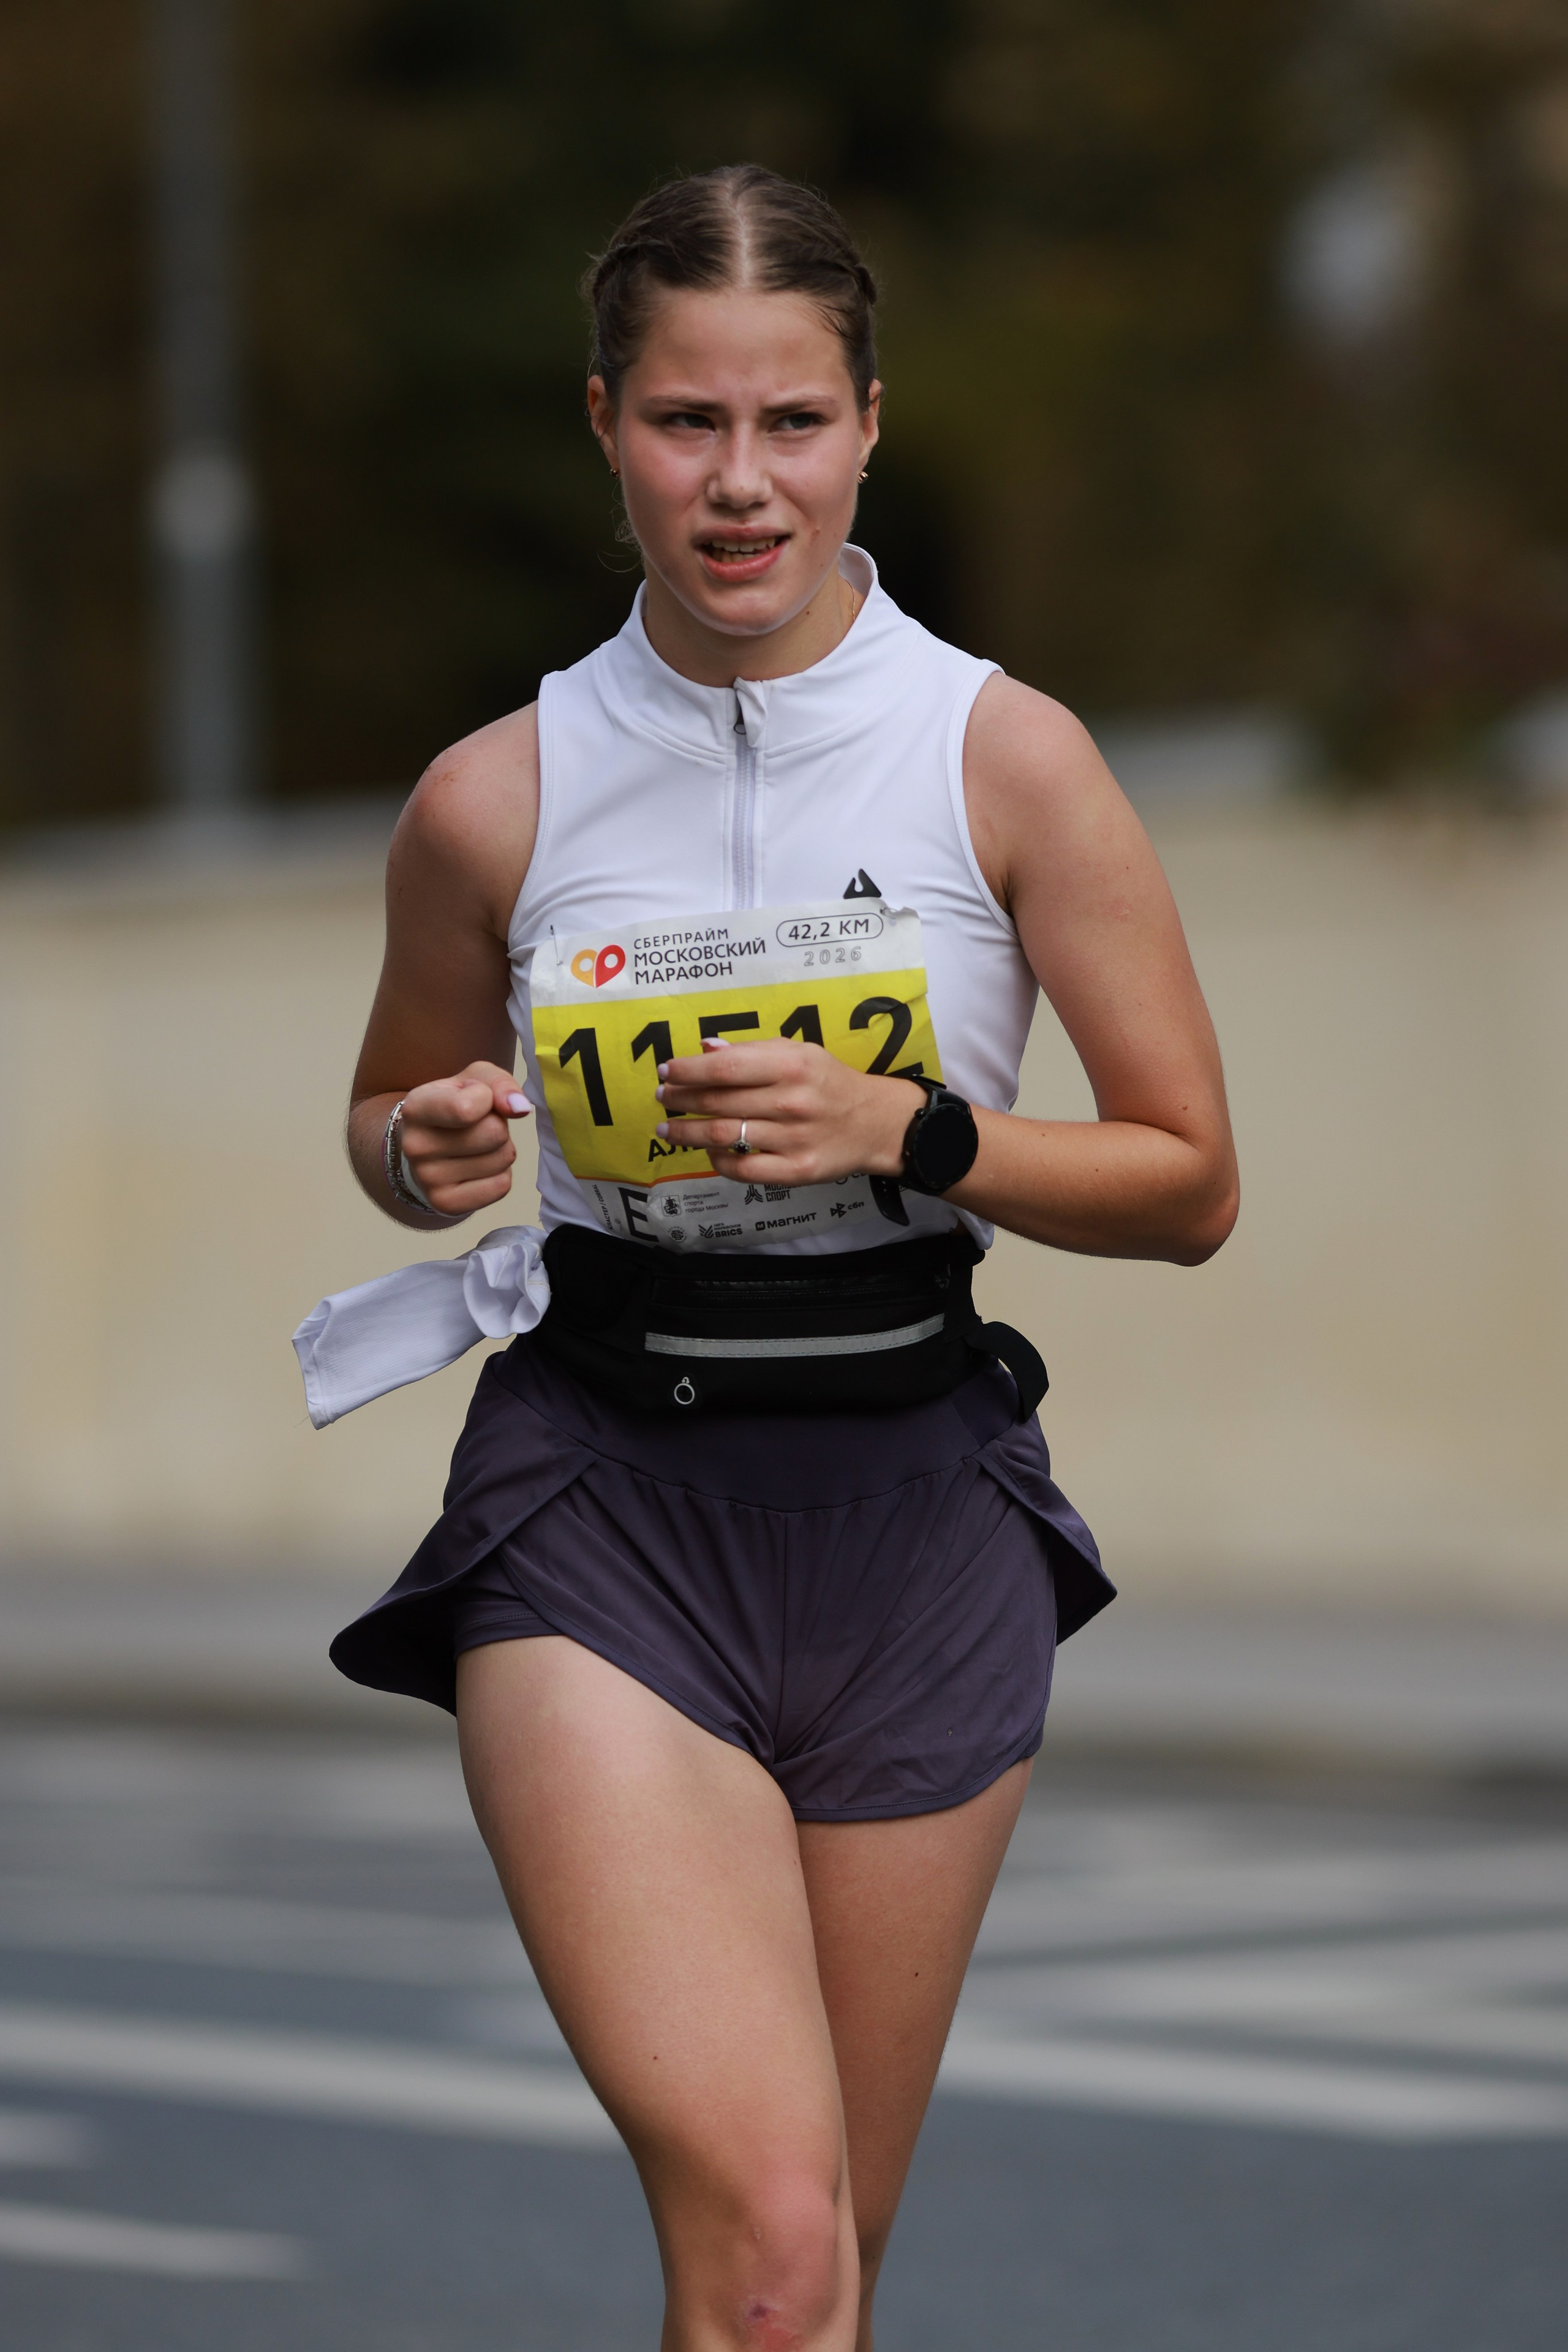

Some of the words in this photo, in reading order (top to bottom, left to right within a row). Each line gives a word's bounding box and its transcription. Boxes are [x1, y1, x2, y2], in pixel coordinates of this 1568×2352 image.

[634, 927, 729, 949] СБЕРПРАЙМ
[788, 922, 831, 940] 42,2
[634, 937, 766, 967] МОСКОВСКИЙ
[804, 946, 861, 966] 2026
[635, 961, 733, 985] МАРАФОН
[592, 1184, 604, 1202] CORRAL
[683, 1191, 720, 1200] Департамент
[766, 1189, 790, 1202] СПОРТ
[601, 1206, 613, 1230] КЛАСТЕР
[715, 1228, 743, 1238] BRICS
